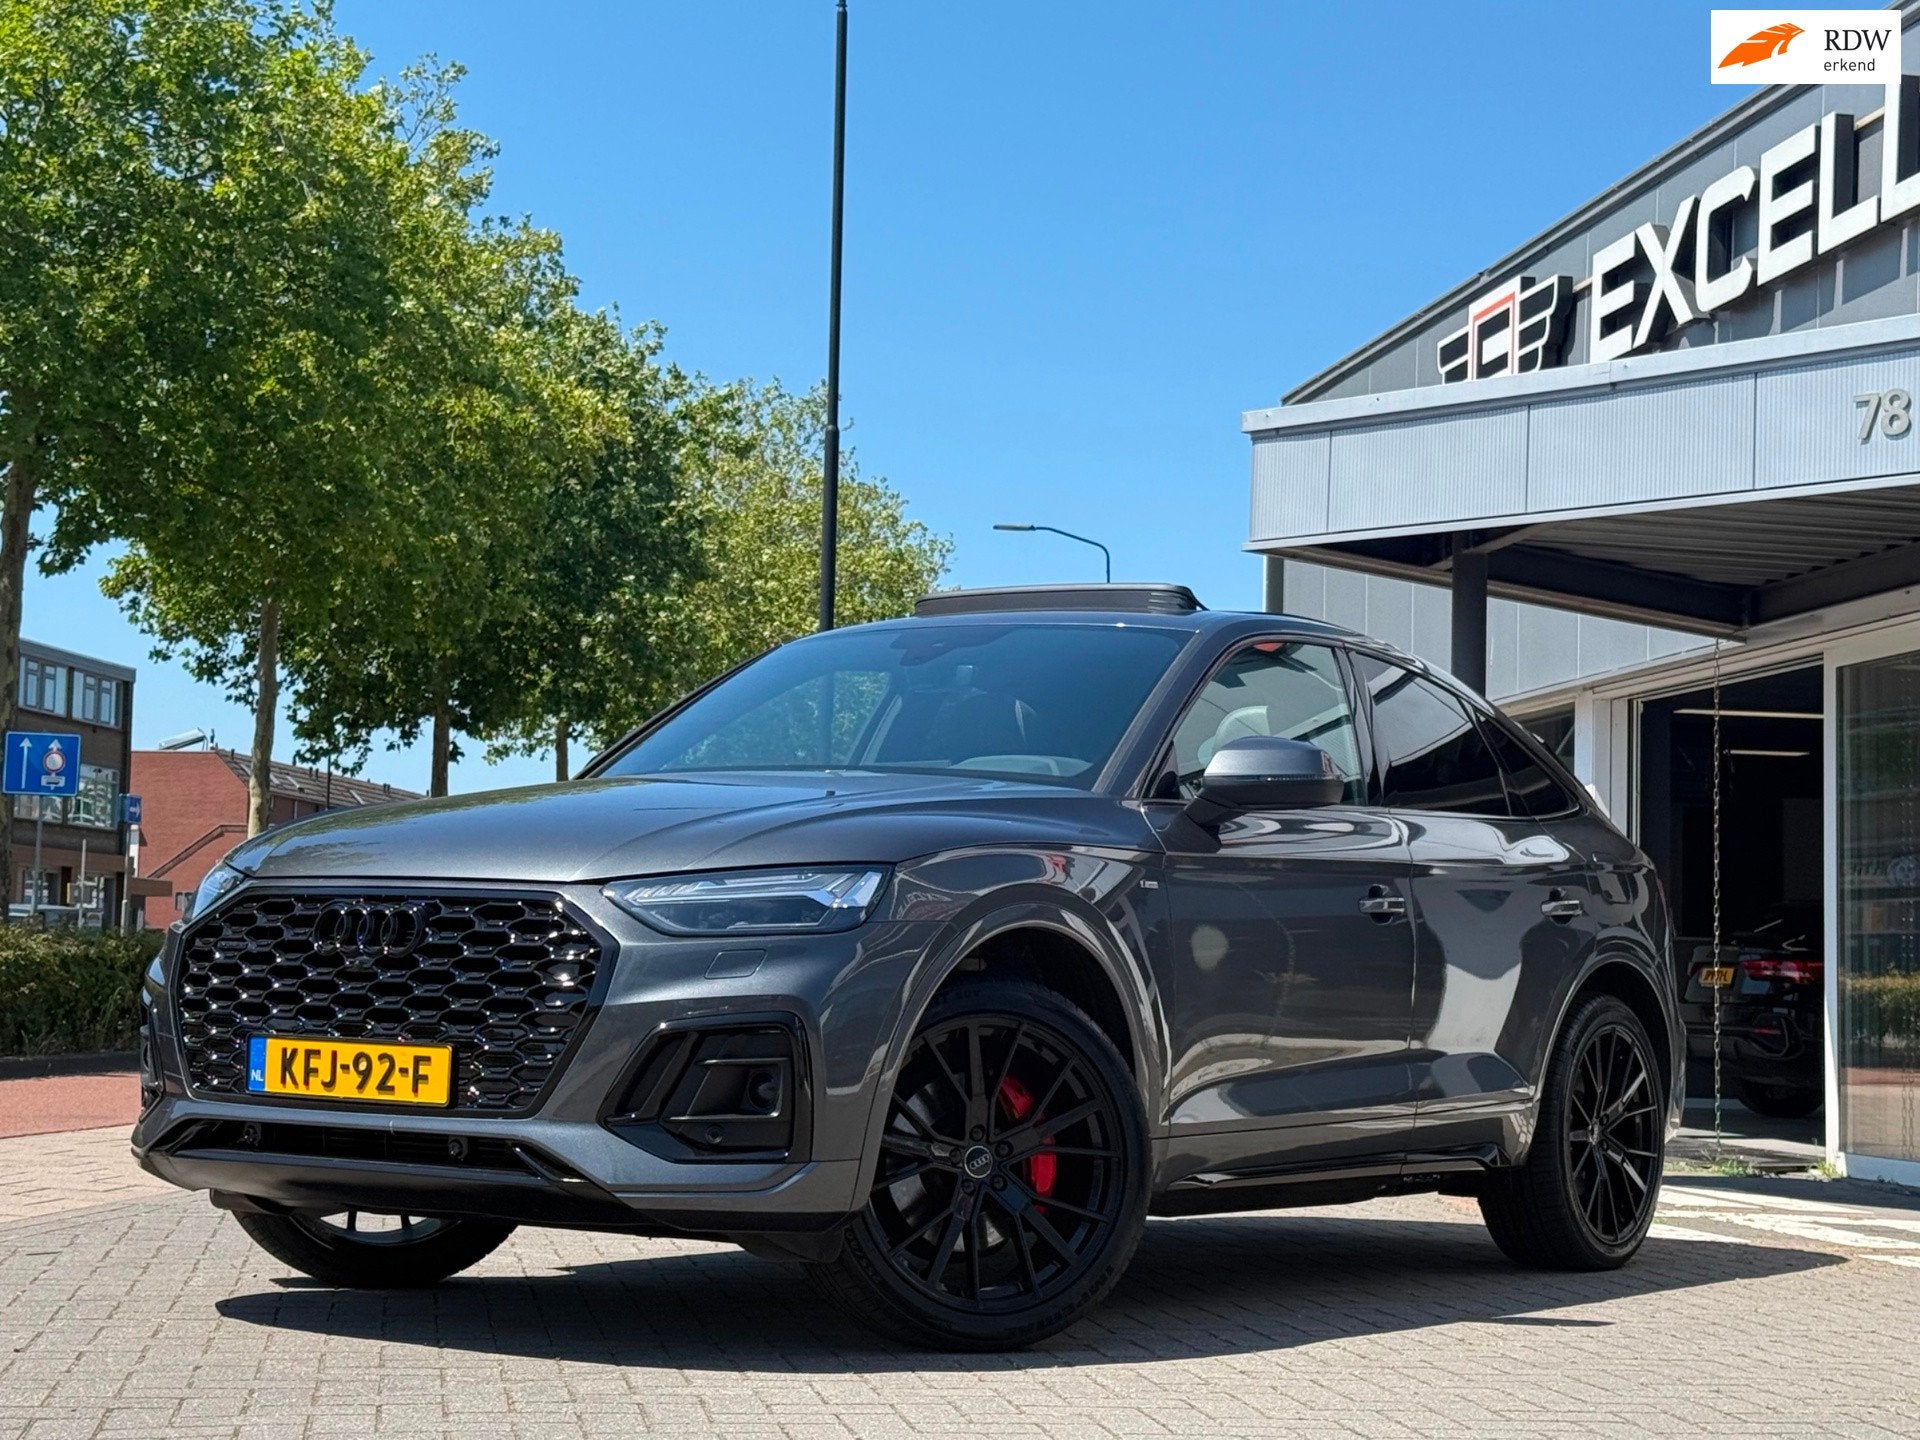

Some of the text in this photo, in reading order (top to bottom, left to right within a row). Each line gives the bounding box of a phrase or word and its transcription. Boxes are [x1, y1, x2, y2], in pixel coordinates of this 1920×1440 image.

[1590, 83, 1920, 363] EXCELL
[1853, 388, 1912, 445] 78
[250, 1070, 264, 1082] NL
[280, 1047, 432, 1097] KFJ-92-F
